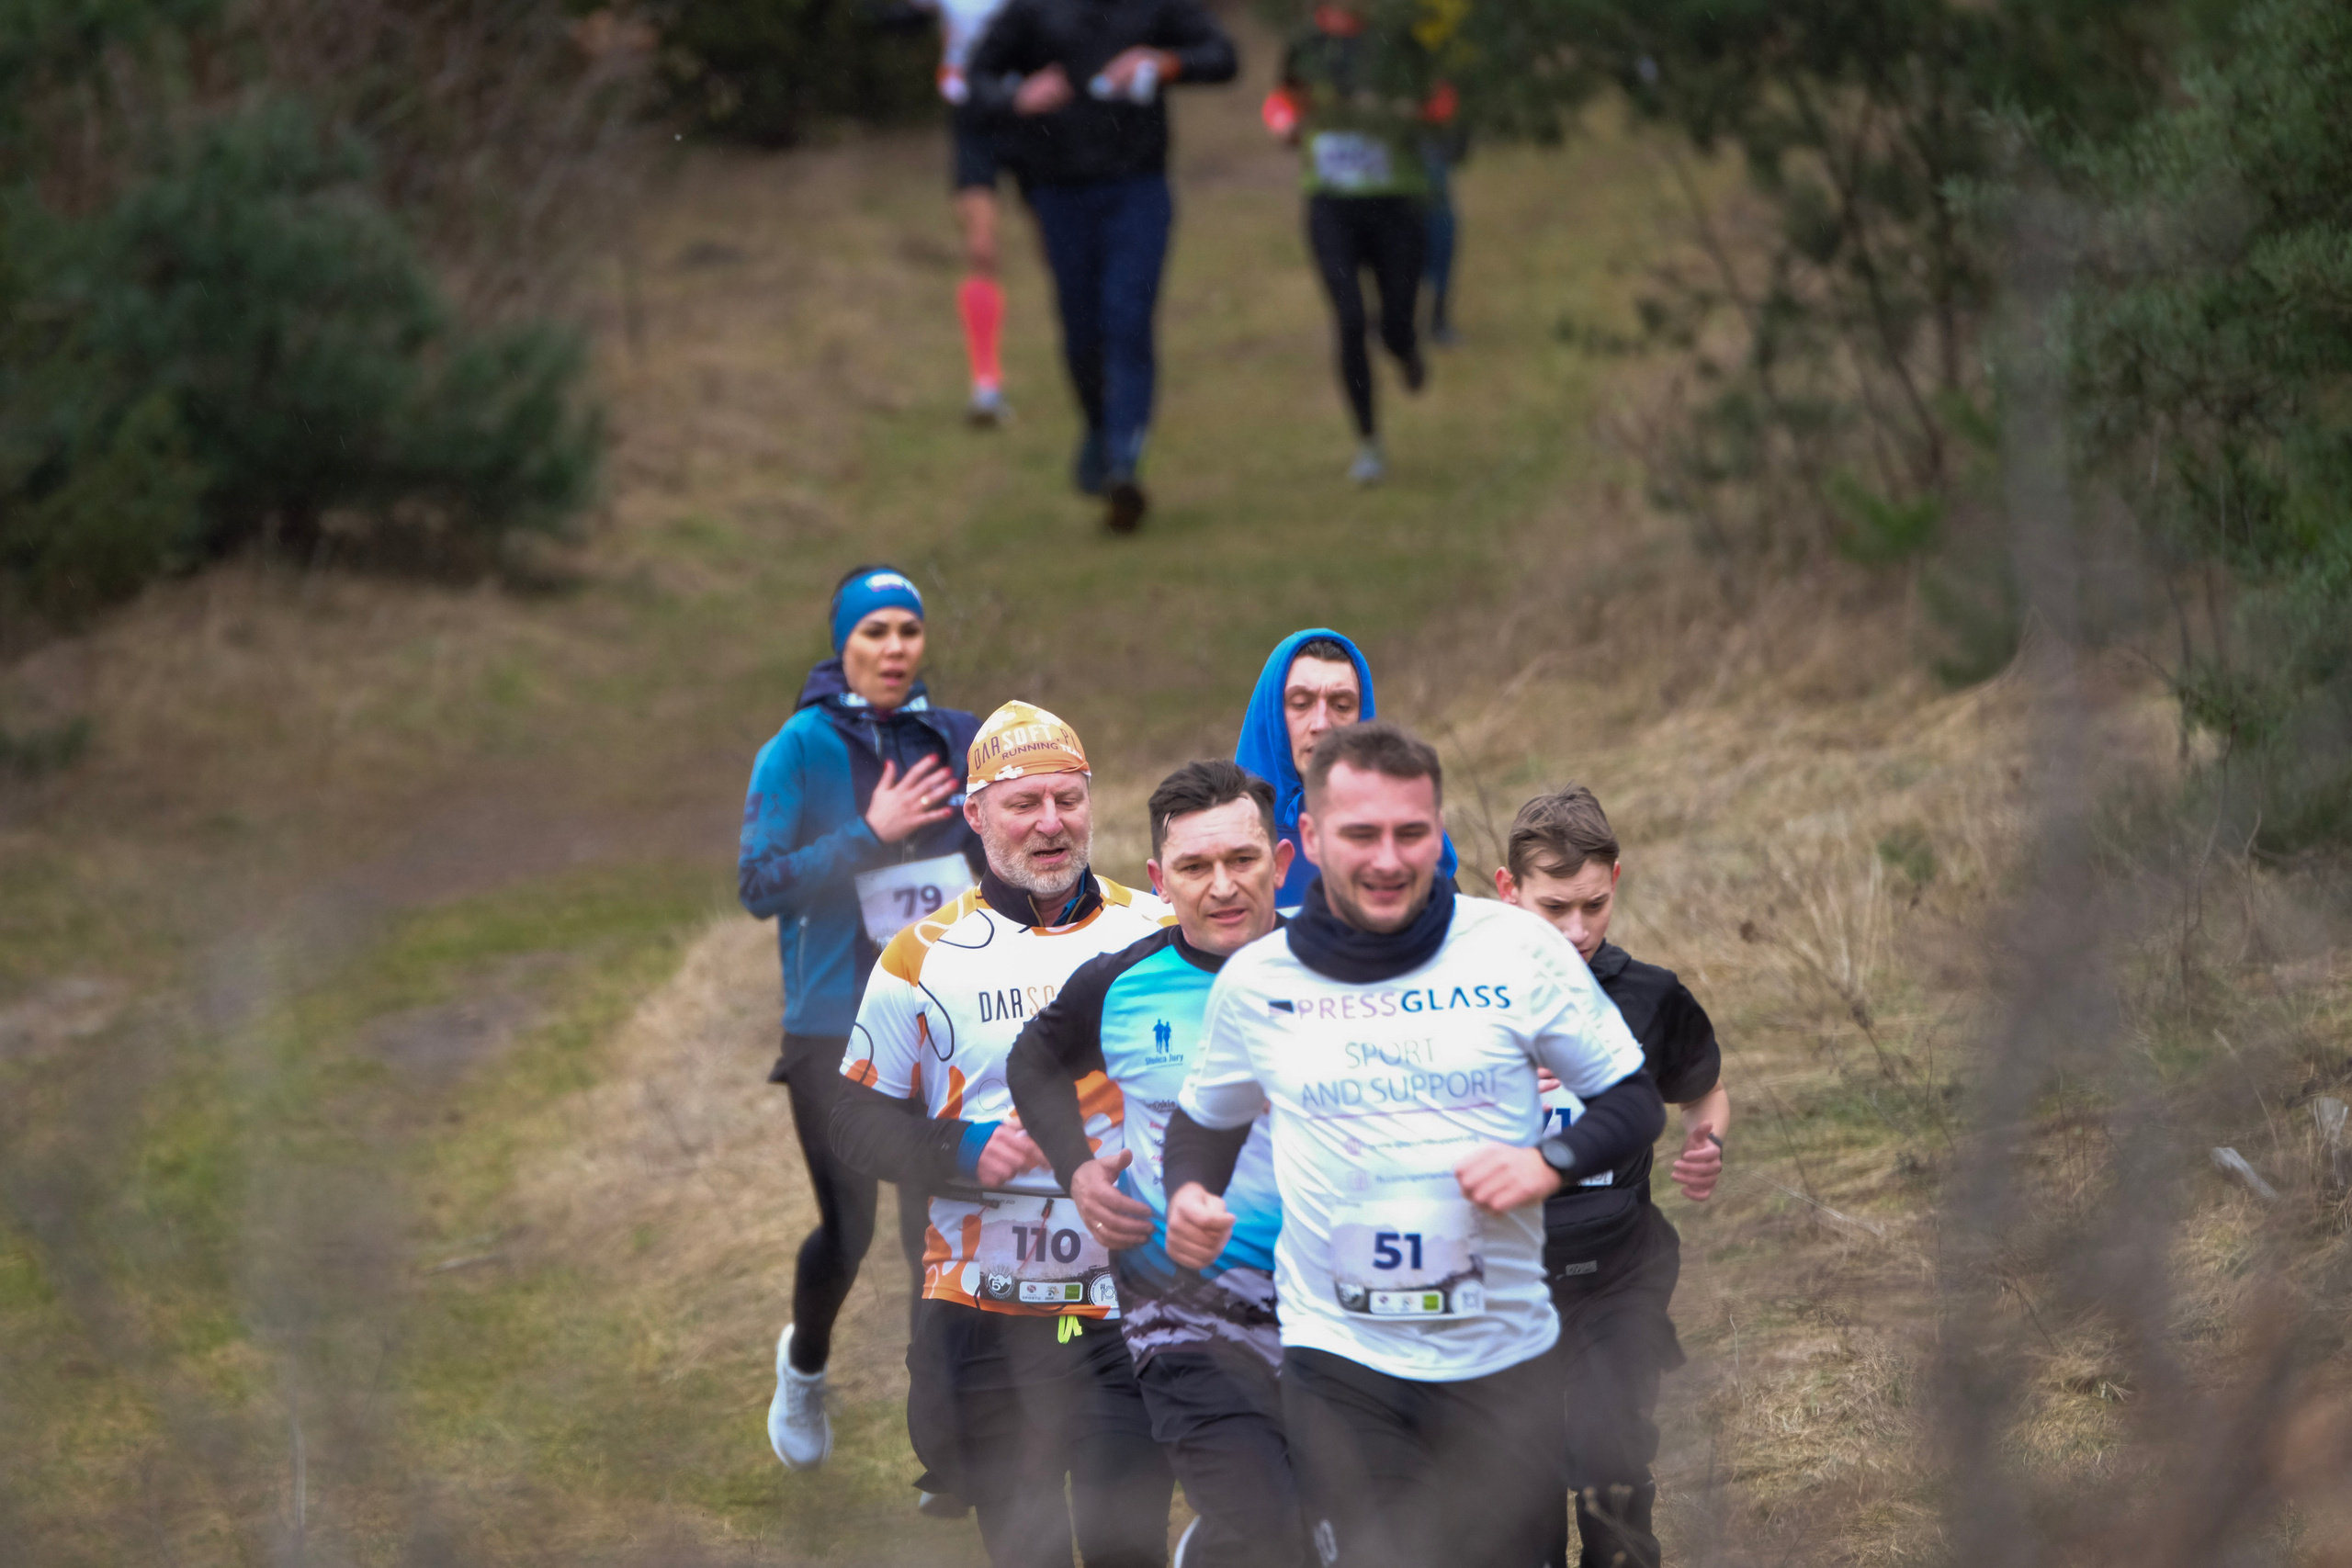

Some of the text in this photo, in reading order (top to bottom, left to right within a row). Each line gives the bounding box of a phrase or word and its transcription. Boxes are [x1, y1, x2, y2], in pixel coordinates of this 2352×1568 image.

[1001, 742, 1058, 761] RUNNING
[893, 885, 943, 919] 79
[1345, 1038, 1433, 1068] SPORT
[1301, 1068, 1498, 1107] AND SUPPORT
[1012, 1225, 1081, 1264] 110
[1373, 1232, 1422, 1270] 51
